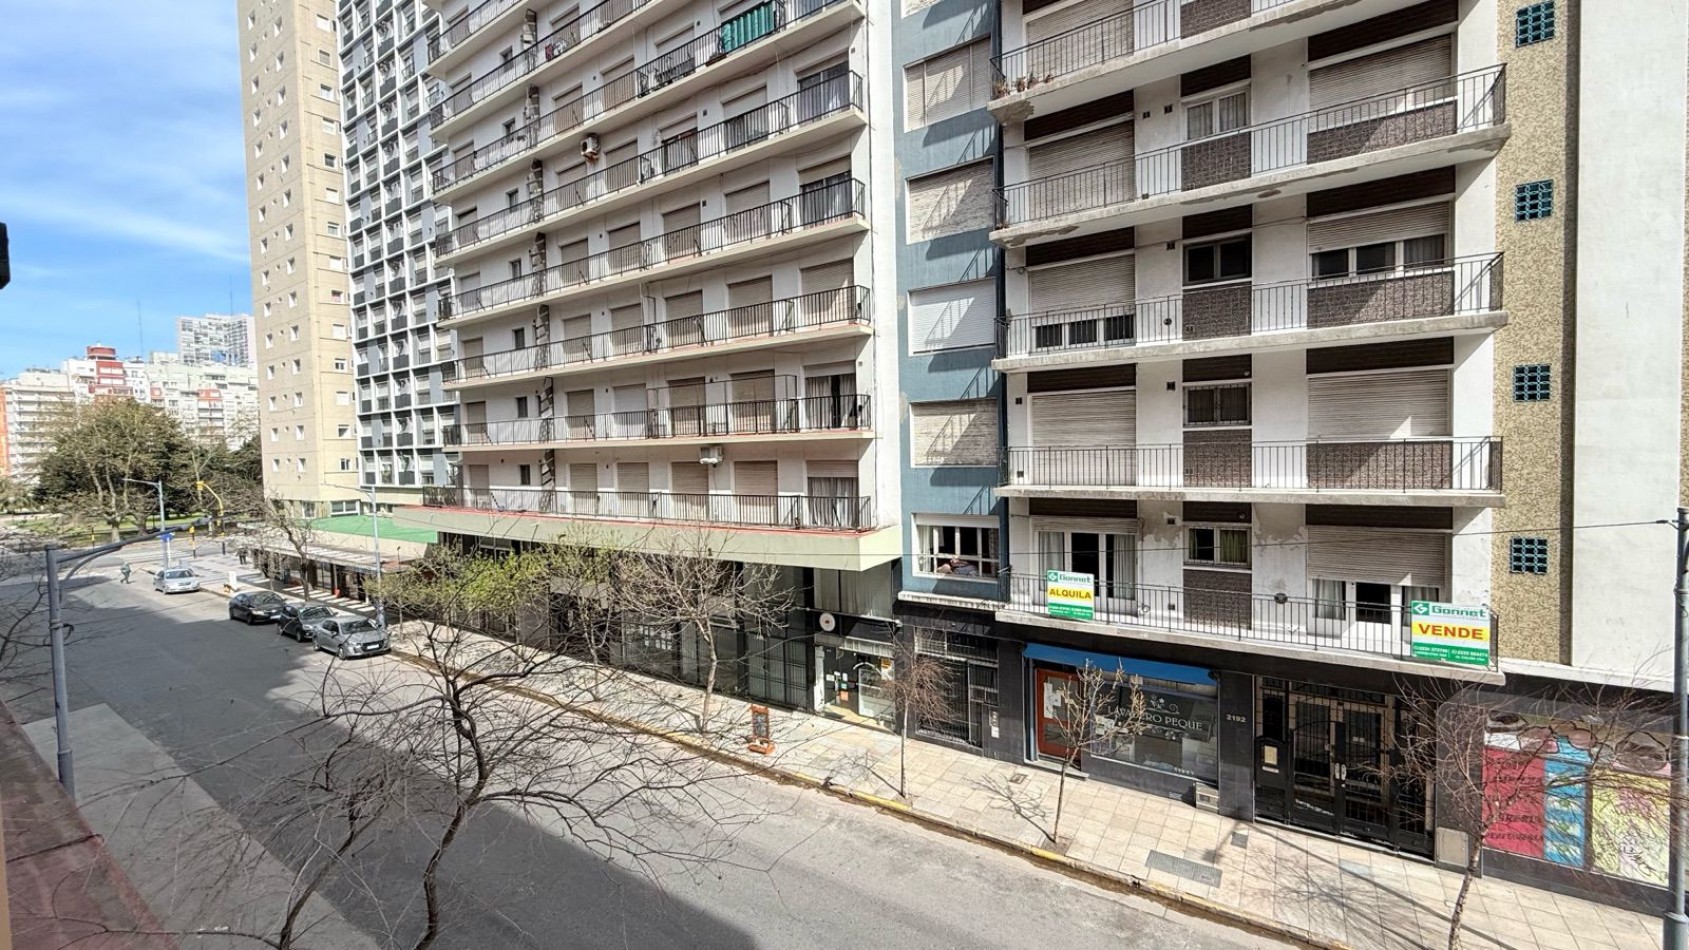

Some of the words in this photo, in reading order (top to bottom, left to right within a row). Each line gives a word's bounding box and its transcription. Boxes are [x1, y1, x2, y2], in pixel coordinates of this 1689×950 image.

[1049, 588, 1092, 600] ALQUILA
[1432, 605, 1487, 618] Gonnet
[1418, 623, 1484, 640] VENDE
[1165, 716, 1203, 731] PEQUE
[1226, 714, 1247, 723] 2192
